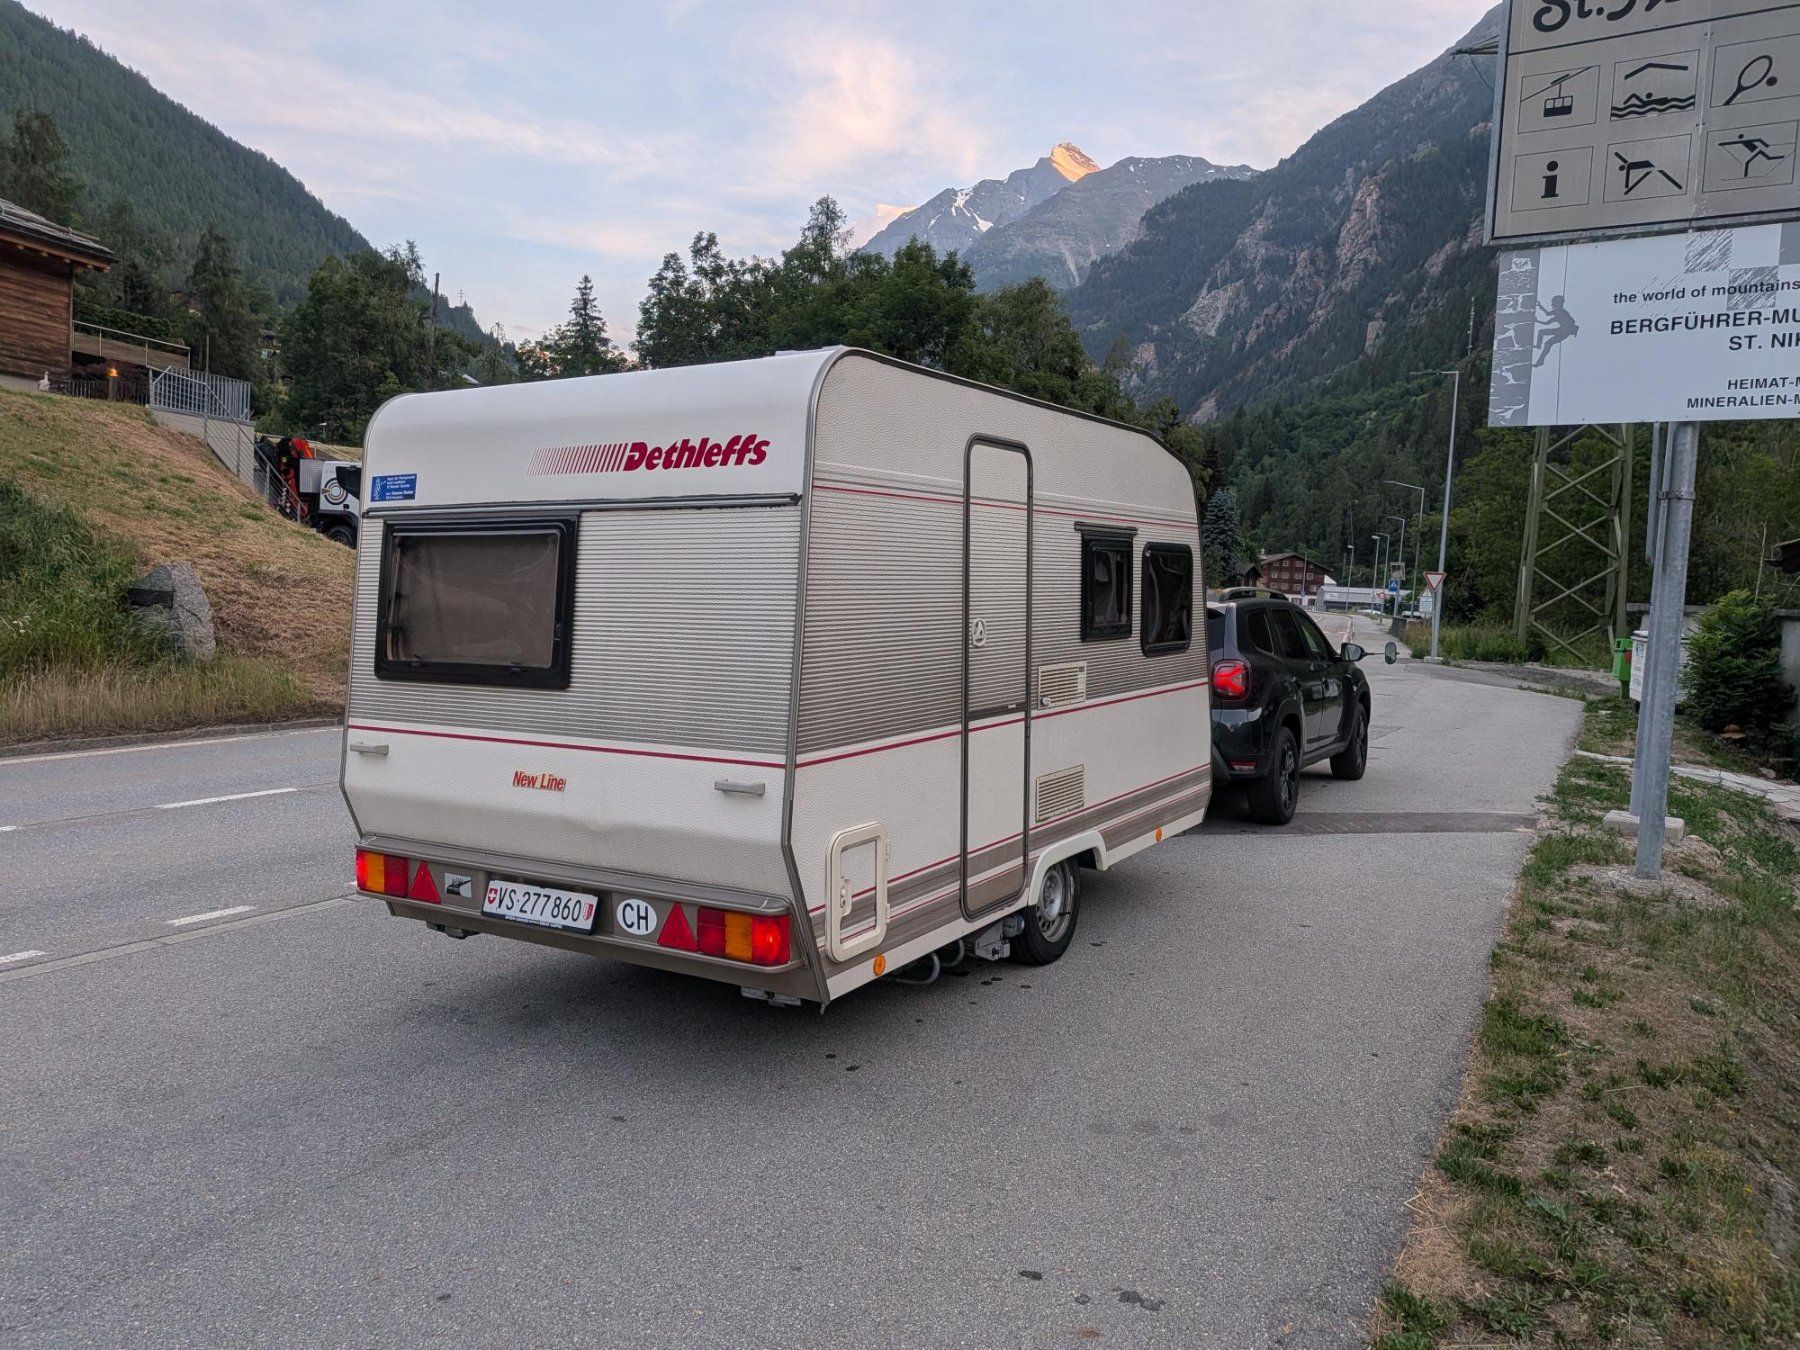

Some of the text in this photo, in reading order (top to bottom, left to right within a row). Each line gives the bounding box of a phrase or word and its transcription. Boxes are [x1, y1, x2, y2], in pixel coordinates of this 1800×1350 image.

[1613, 279, 1800, 304] the world of mountains
[1728, 334, 1762, 351] ST.
[623, 433, 771, 472] Dethleffs
[512, 771, 566, 790] New Line
[622, 902, 649, 932] CH
